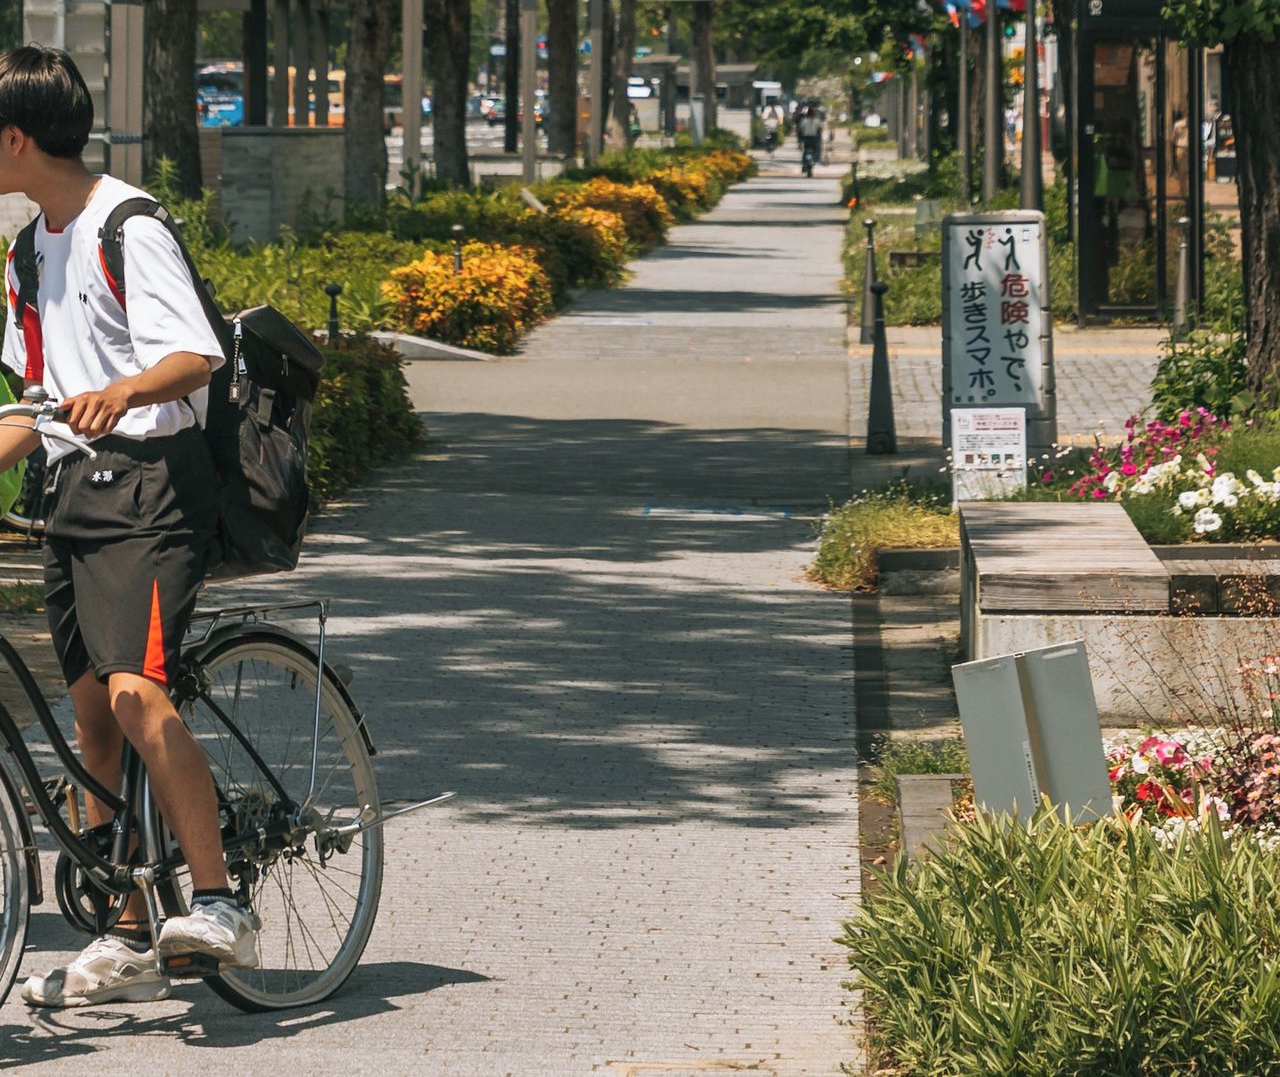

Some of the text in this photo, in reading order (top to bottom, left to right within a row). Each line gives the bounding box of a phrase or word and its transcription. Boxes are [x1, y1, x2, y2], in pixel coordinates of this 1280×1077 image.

[960, 281, 997, 398] 歩きスマホ。
